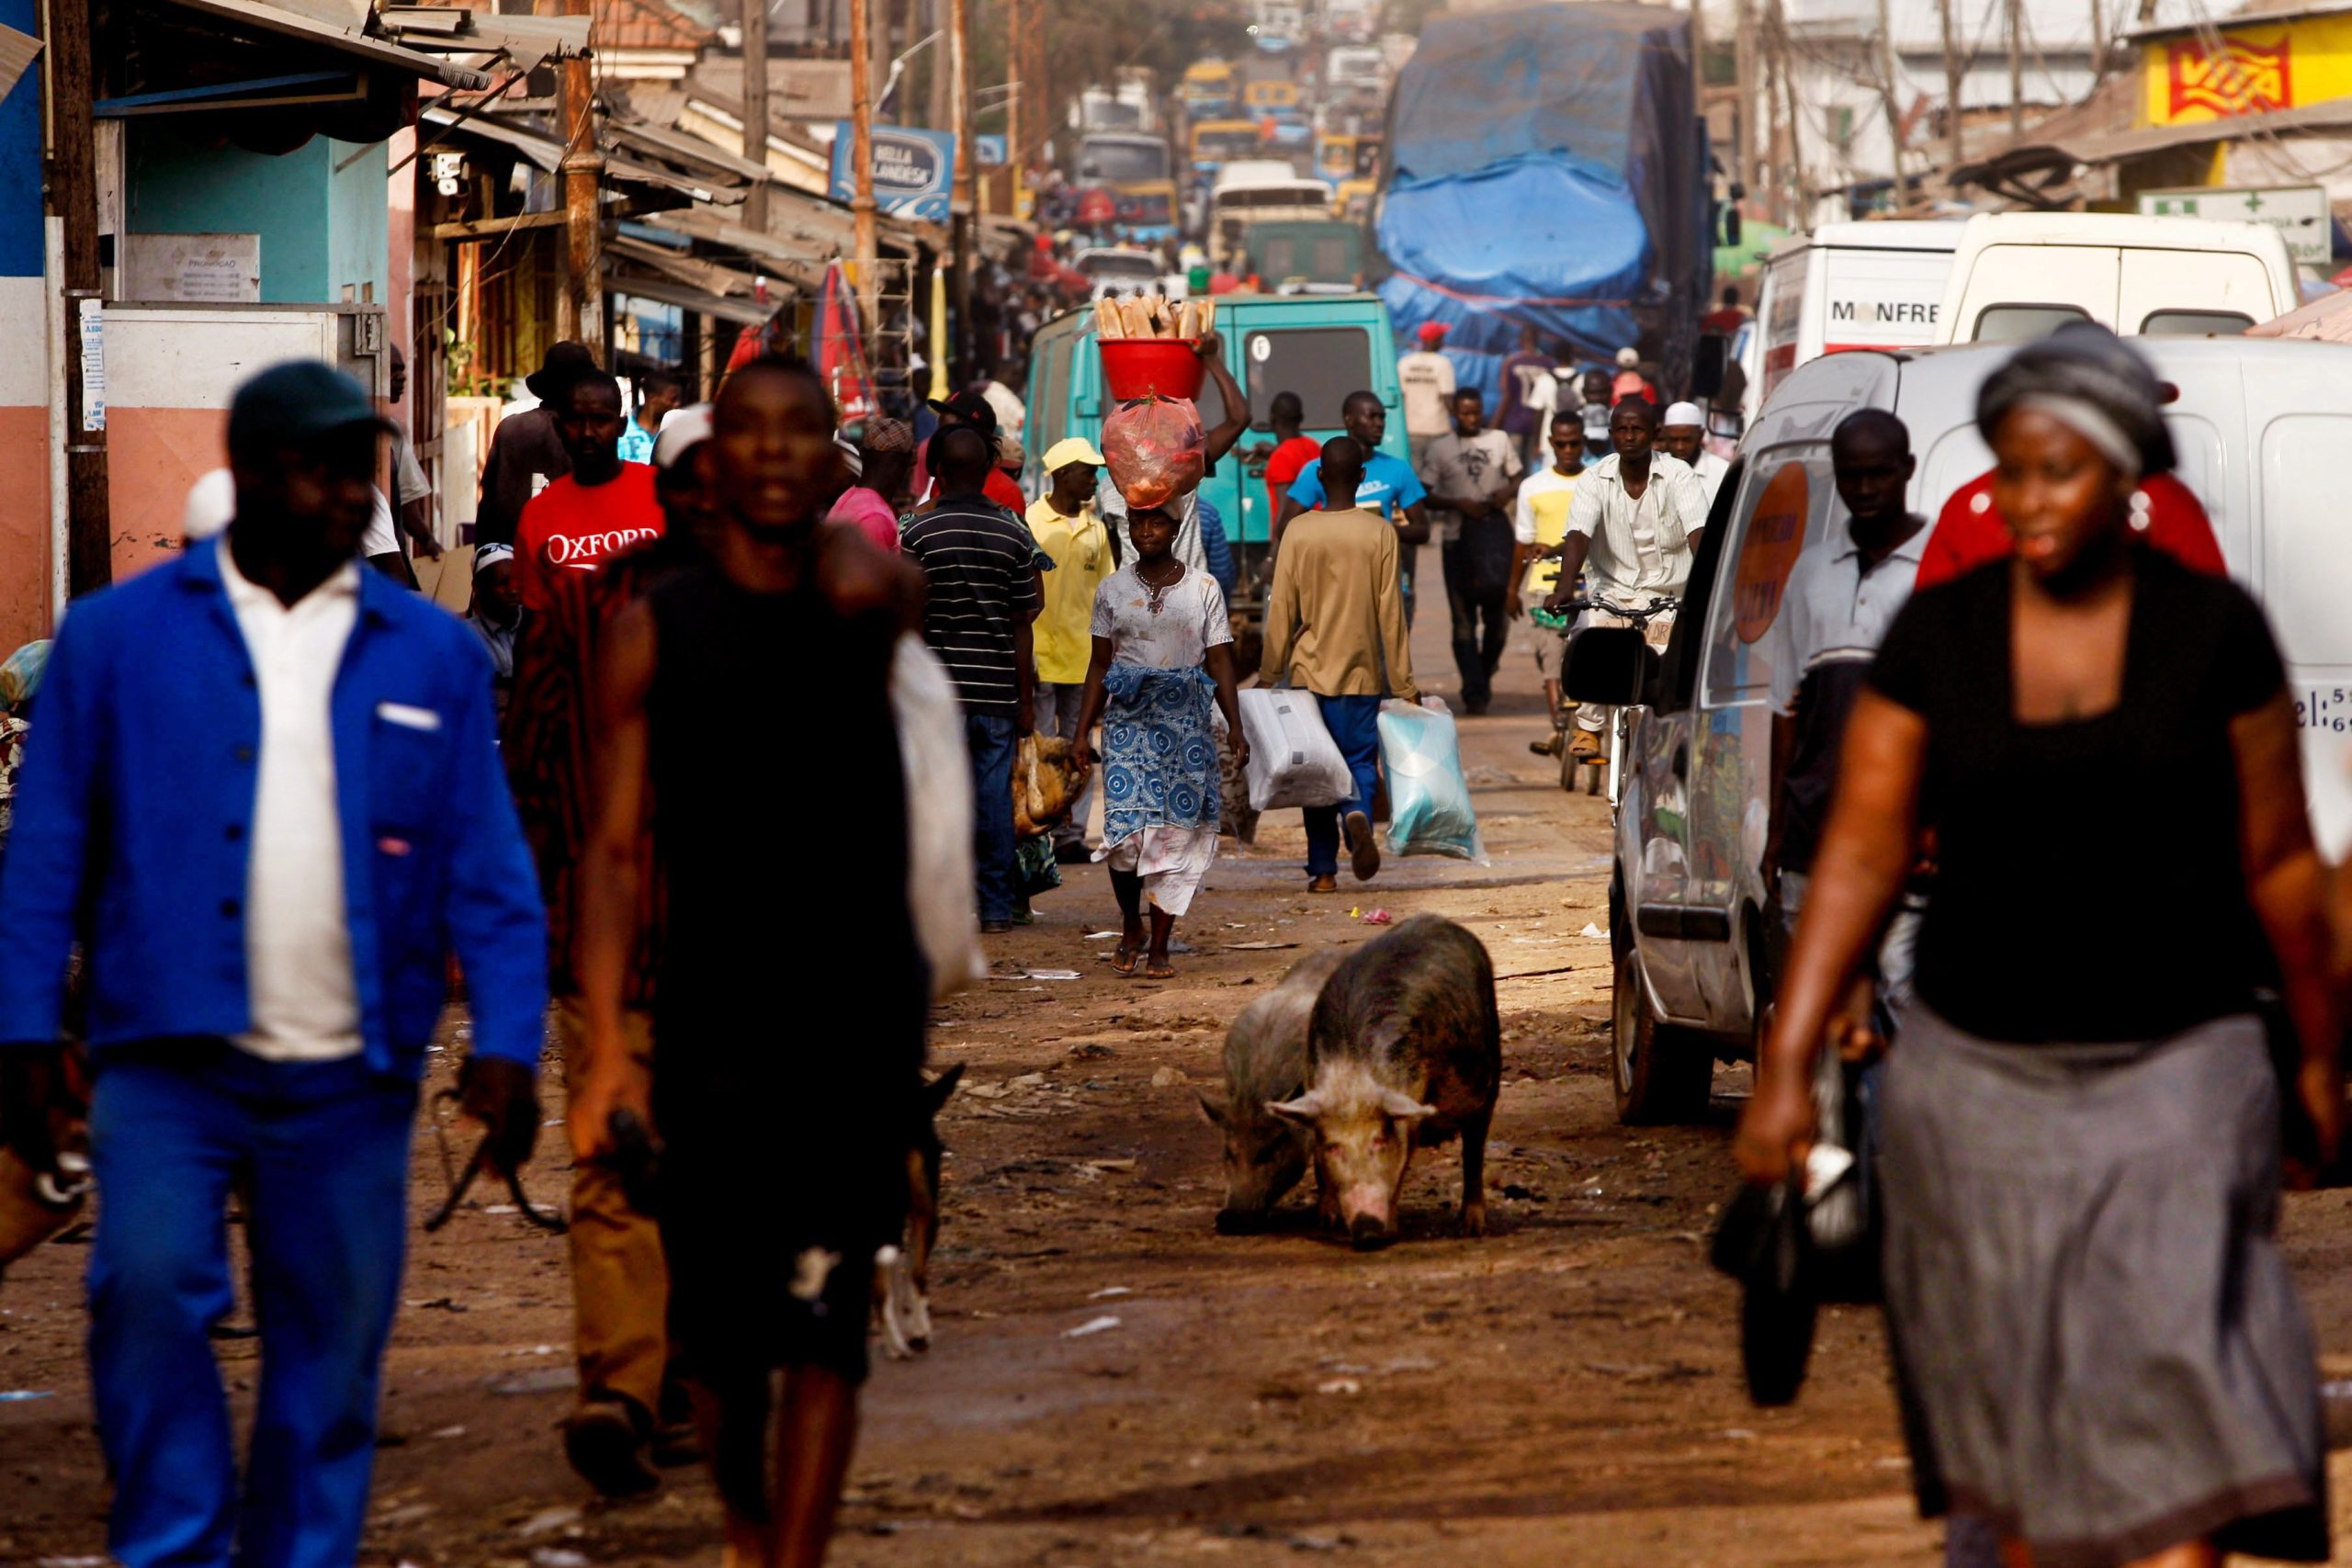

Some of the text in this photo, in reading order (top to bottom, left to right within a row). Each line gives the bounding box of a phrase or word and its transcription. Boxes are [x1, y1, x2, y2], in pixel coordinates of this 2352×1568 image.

[2180, 51, 2282, 103] VITA
[870, 162, 928, 186] LANDESA
[548, 527, 658, 564] OXFORD
[2334, 689, 2352, 705] 5
[2334, 717, 2352, 732] 6
